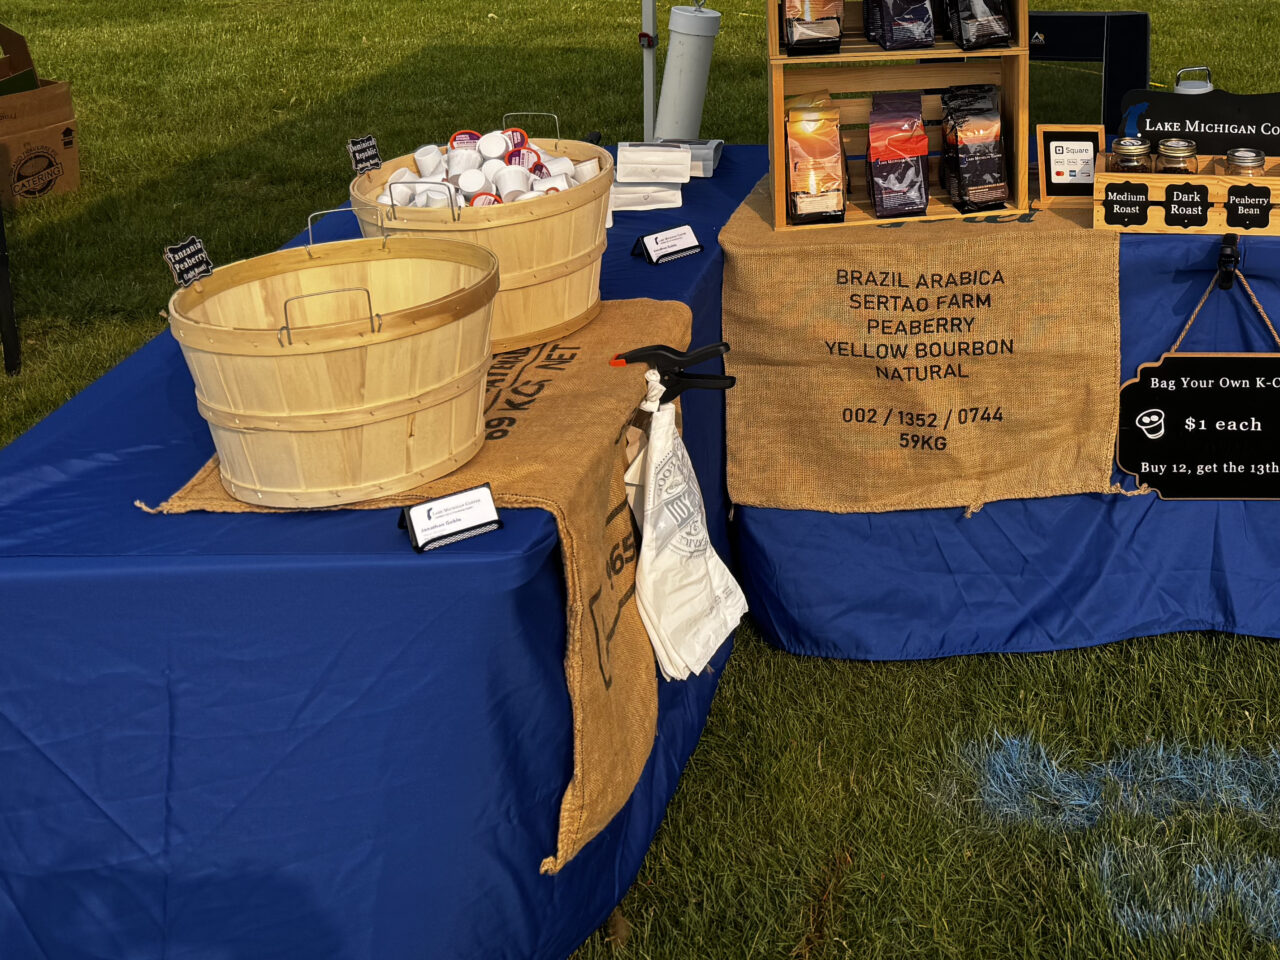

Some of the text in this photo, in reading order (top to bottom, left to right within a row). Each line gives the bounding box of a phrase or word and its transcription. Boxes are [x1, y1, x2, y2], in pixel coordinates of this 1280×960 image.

[1145, 118, 1181, 132] LAKE
[1185, 119, 1257, 135] MICHIGAN
[1065, 147, 1089, 155] Square
[13, 166, 61, 194] CATERING
[1108, 191, 1146, 202] Medium
[1172, 191, 1201, 203] Dark
[1229, 195, 1269, 208] Peaberry
[1112, 203, 1140, 215] Roast
[1170, 203, 1203, 216] Roast
[1237, 205, 1260, 216] Bean
[167, 242, 202, 262] Tanzania
[174, 251, 207, 273] Peaberry
[836, 269, 1005, 289] BRAZIL ARABICA
[849, 293, 992, 312] SERTAO FARM
[867, 317, 975, 336] PEABERRY
[534, 343, 582, 371] NET
[825, 338, 1014, 359] YELLOW BOURBON
[876, 363, 970, 382] NATURAL
[1150, 377, 1176, 390] Bag
[1181, 377, 1215, 388] Your
[1219, 377, 1250, 388] Own
[842, 407, 878, 424] 002
[898, 410, 938, 428] 1352
[958, 406, 1004, 425] 0744
[1184, 416, 1263, 432] $1 each
[900, 433, 948, 451] 59KG
[1140, 462, 1167, 475] Buy
[1172, 463, 1192, 475] 12,
[1196, 463, 1219, 475] get
[1223, 462, 1246, 473] the
[1250, 462, 1280, 475] 13th
